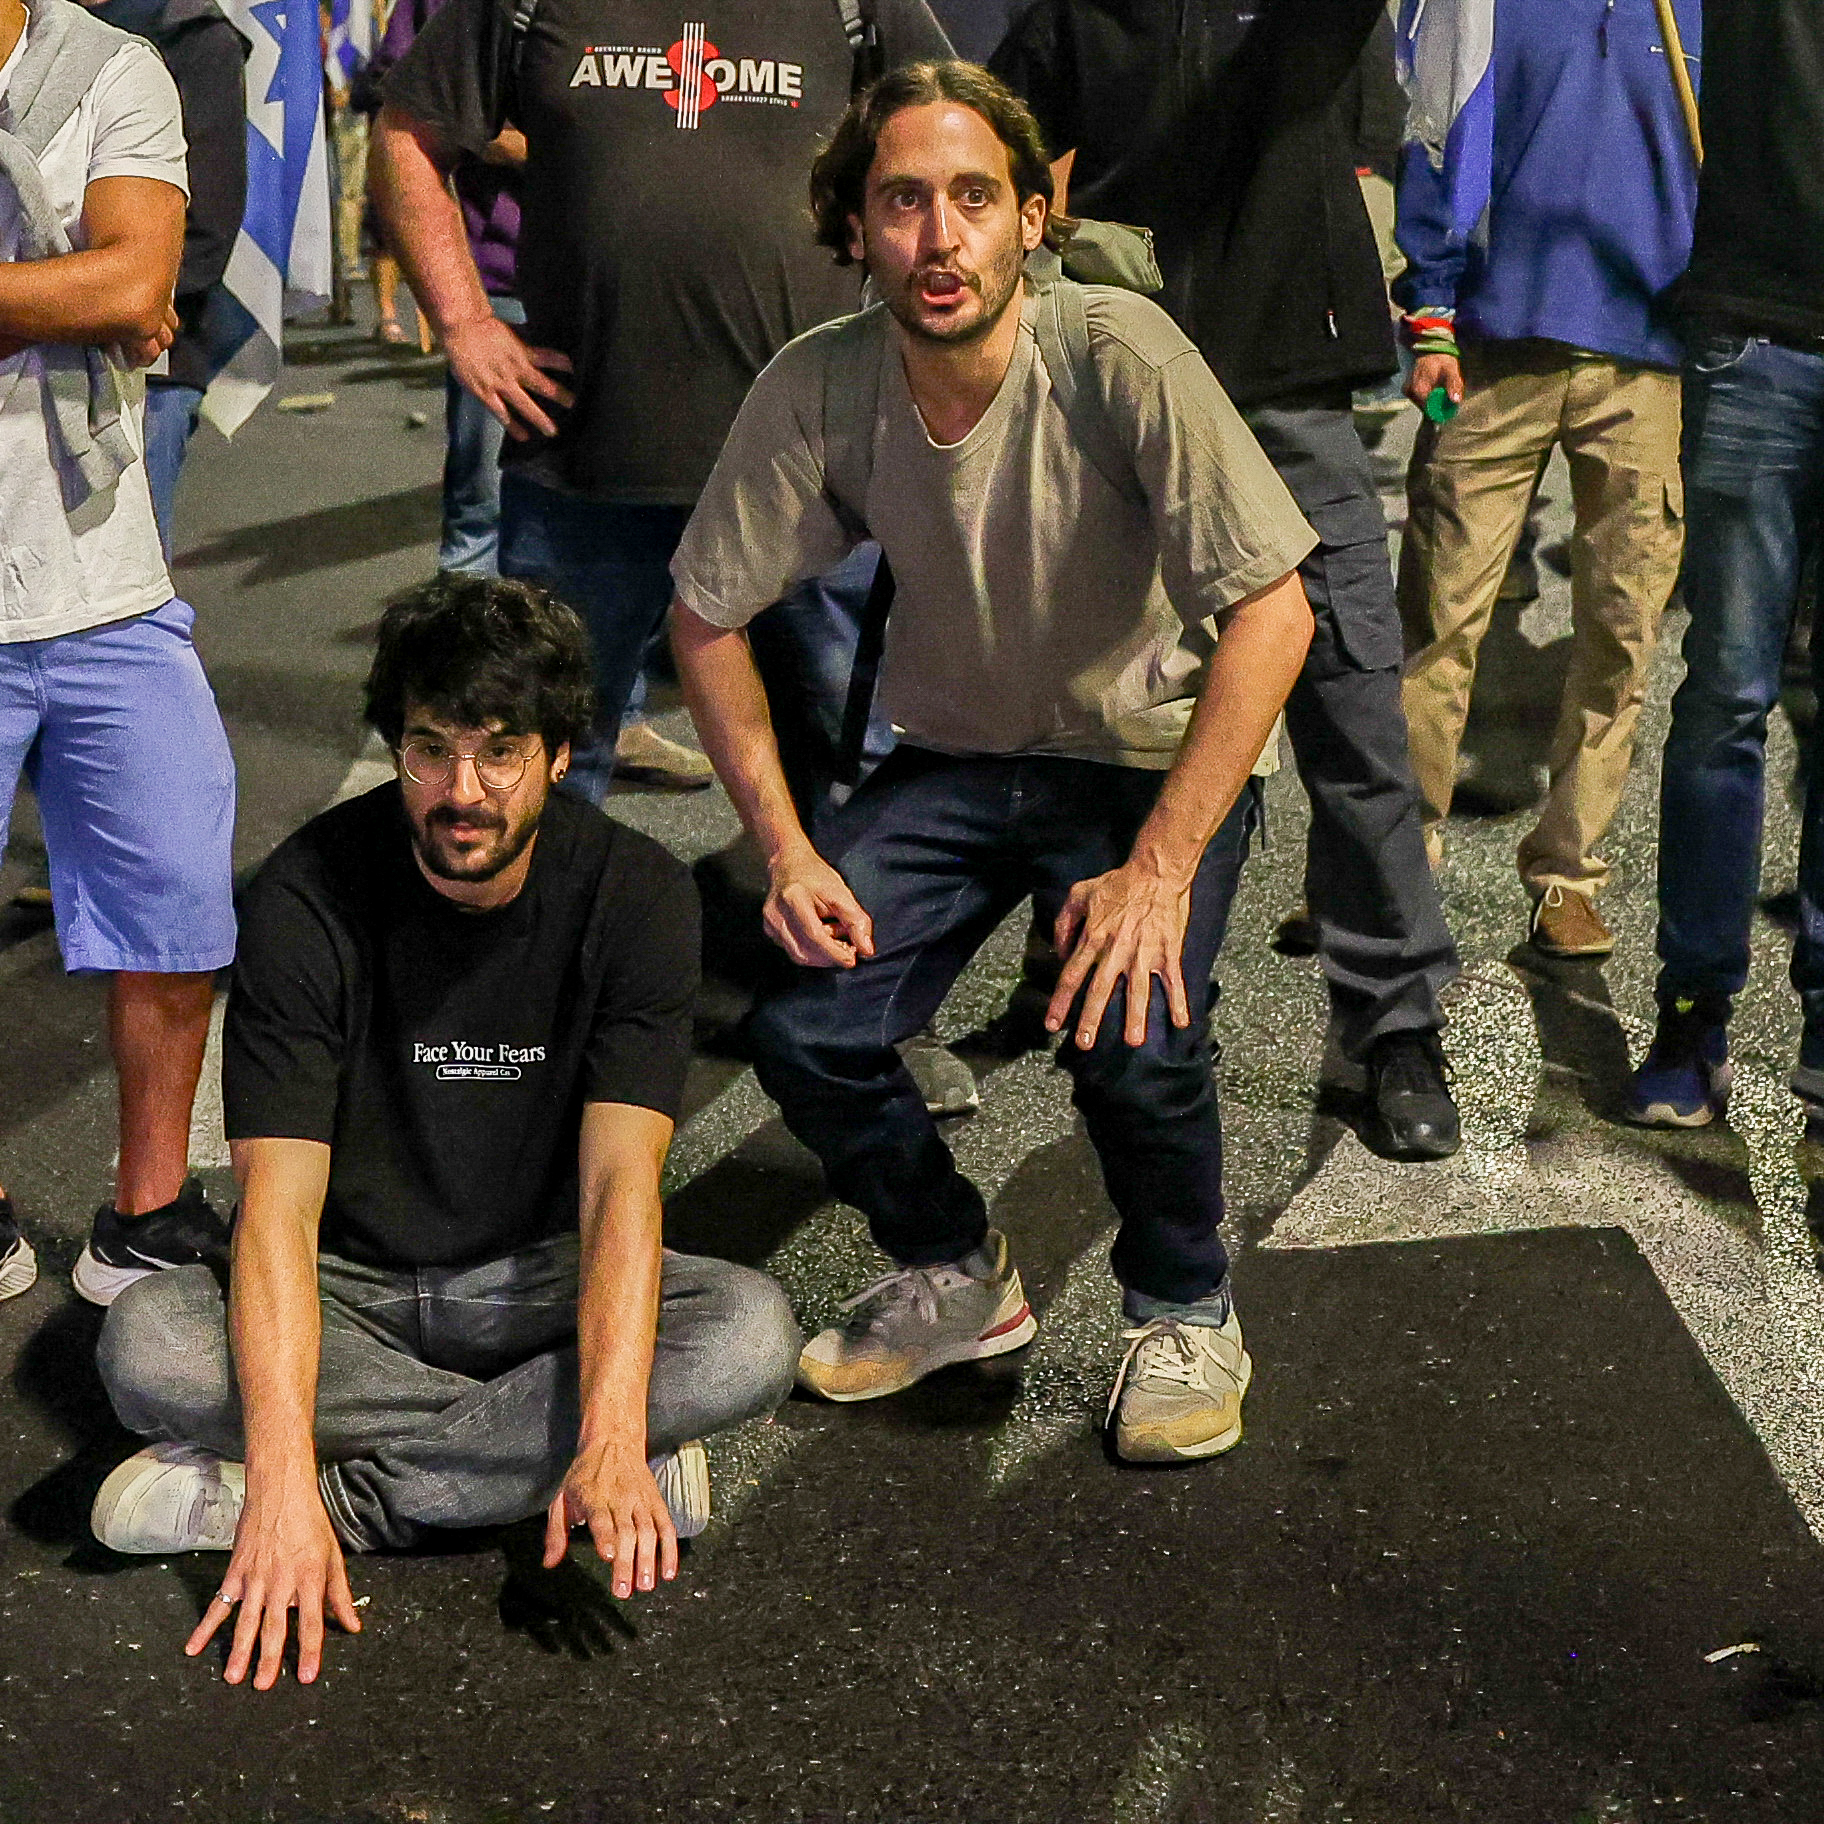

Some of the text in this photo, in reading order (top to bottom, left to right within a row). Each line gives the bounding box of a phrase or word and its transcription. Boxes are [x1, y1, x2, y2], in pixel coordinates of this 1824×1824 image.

[413, 1040, 546, 1063] Face Your Fears
